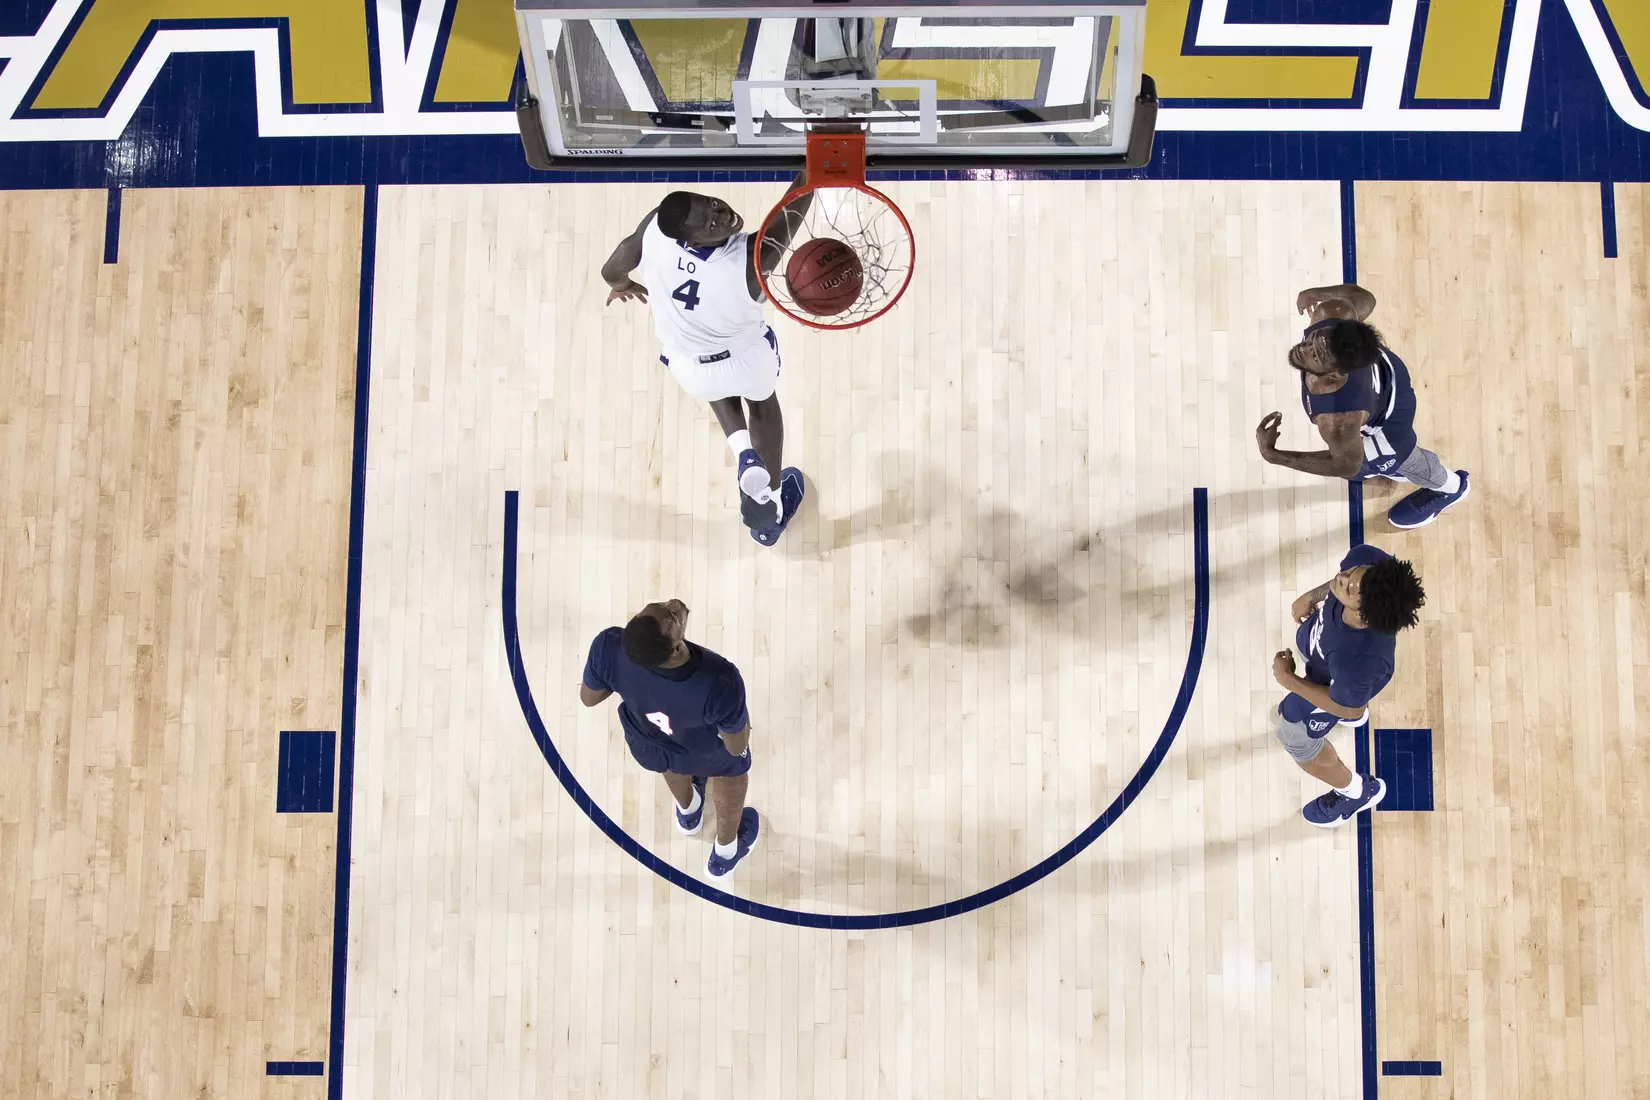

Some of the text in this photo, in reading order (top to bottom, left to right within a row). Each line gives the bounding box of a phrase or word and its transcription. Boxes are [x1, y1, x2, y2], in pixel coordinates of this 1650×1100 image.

[677, 256, 696, 274] LO
[672, 278, 700, 311] 4
[645, 711, 673, 736] 4
